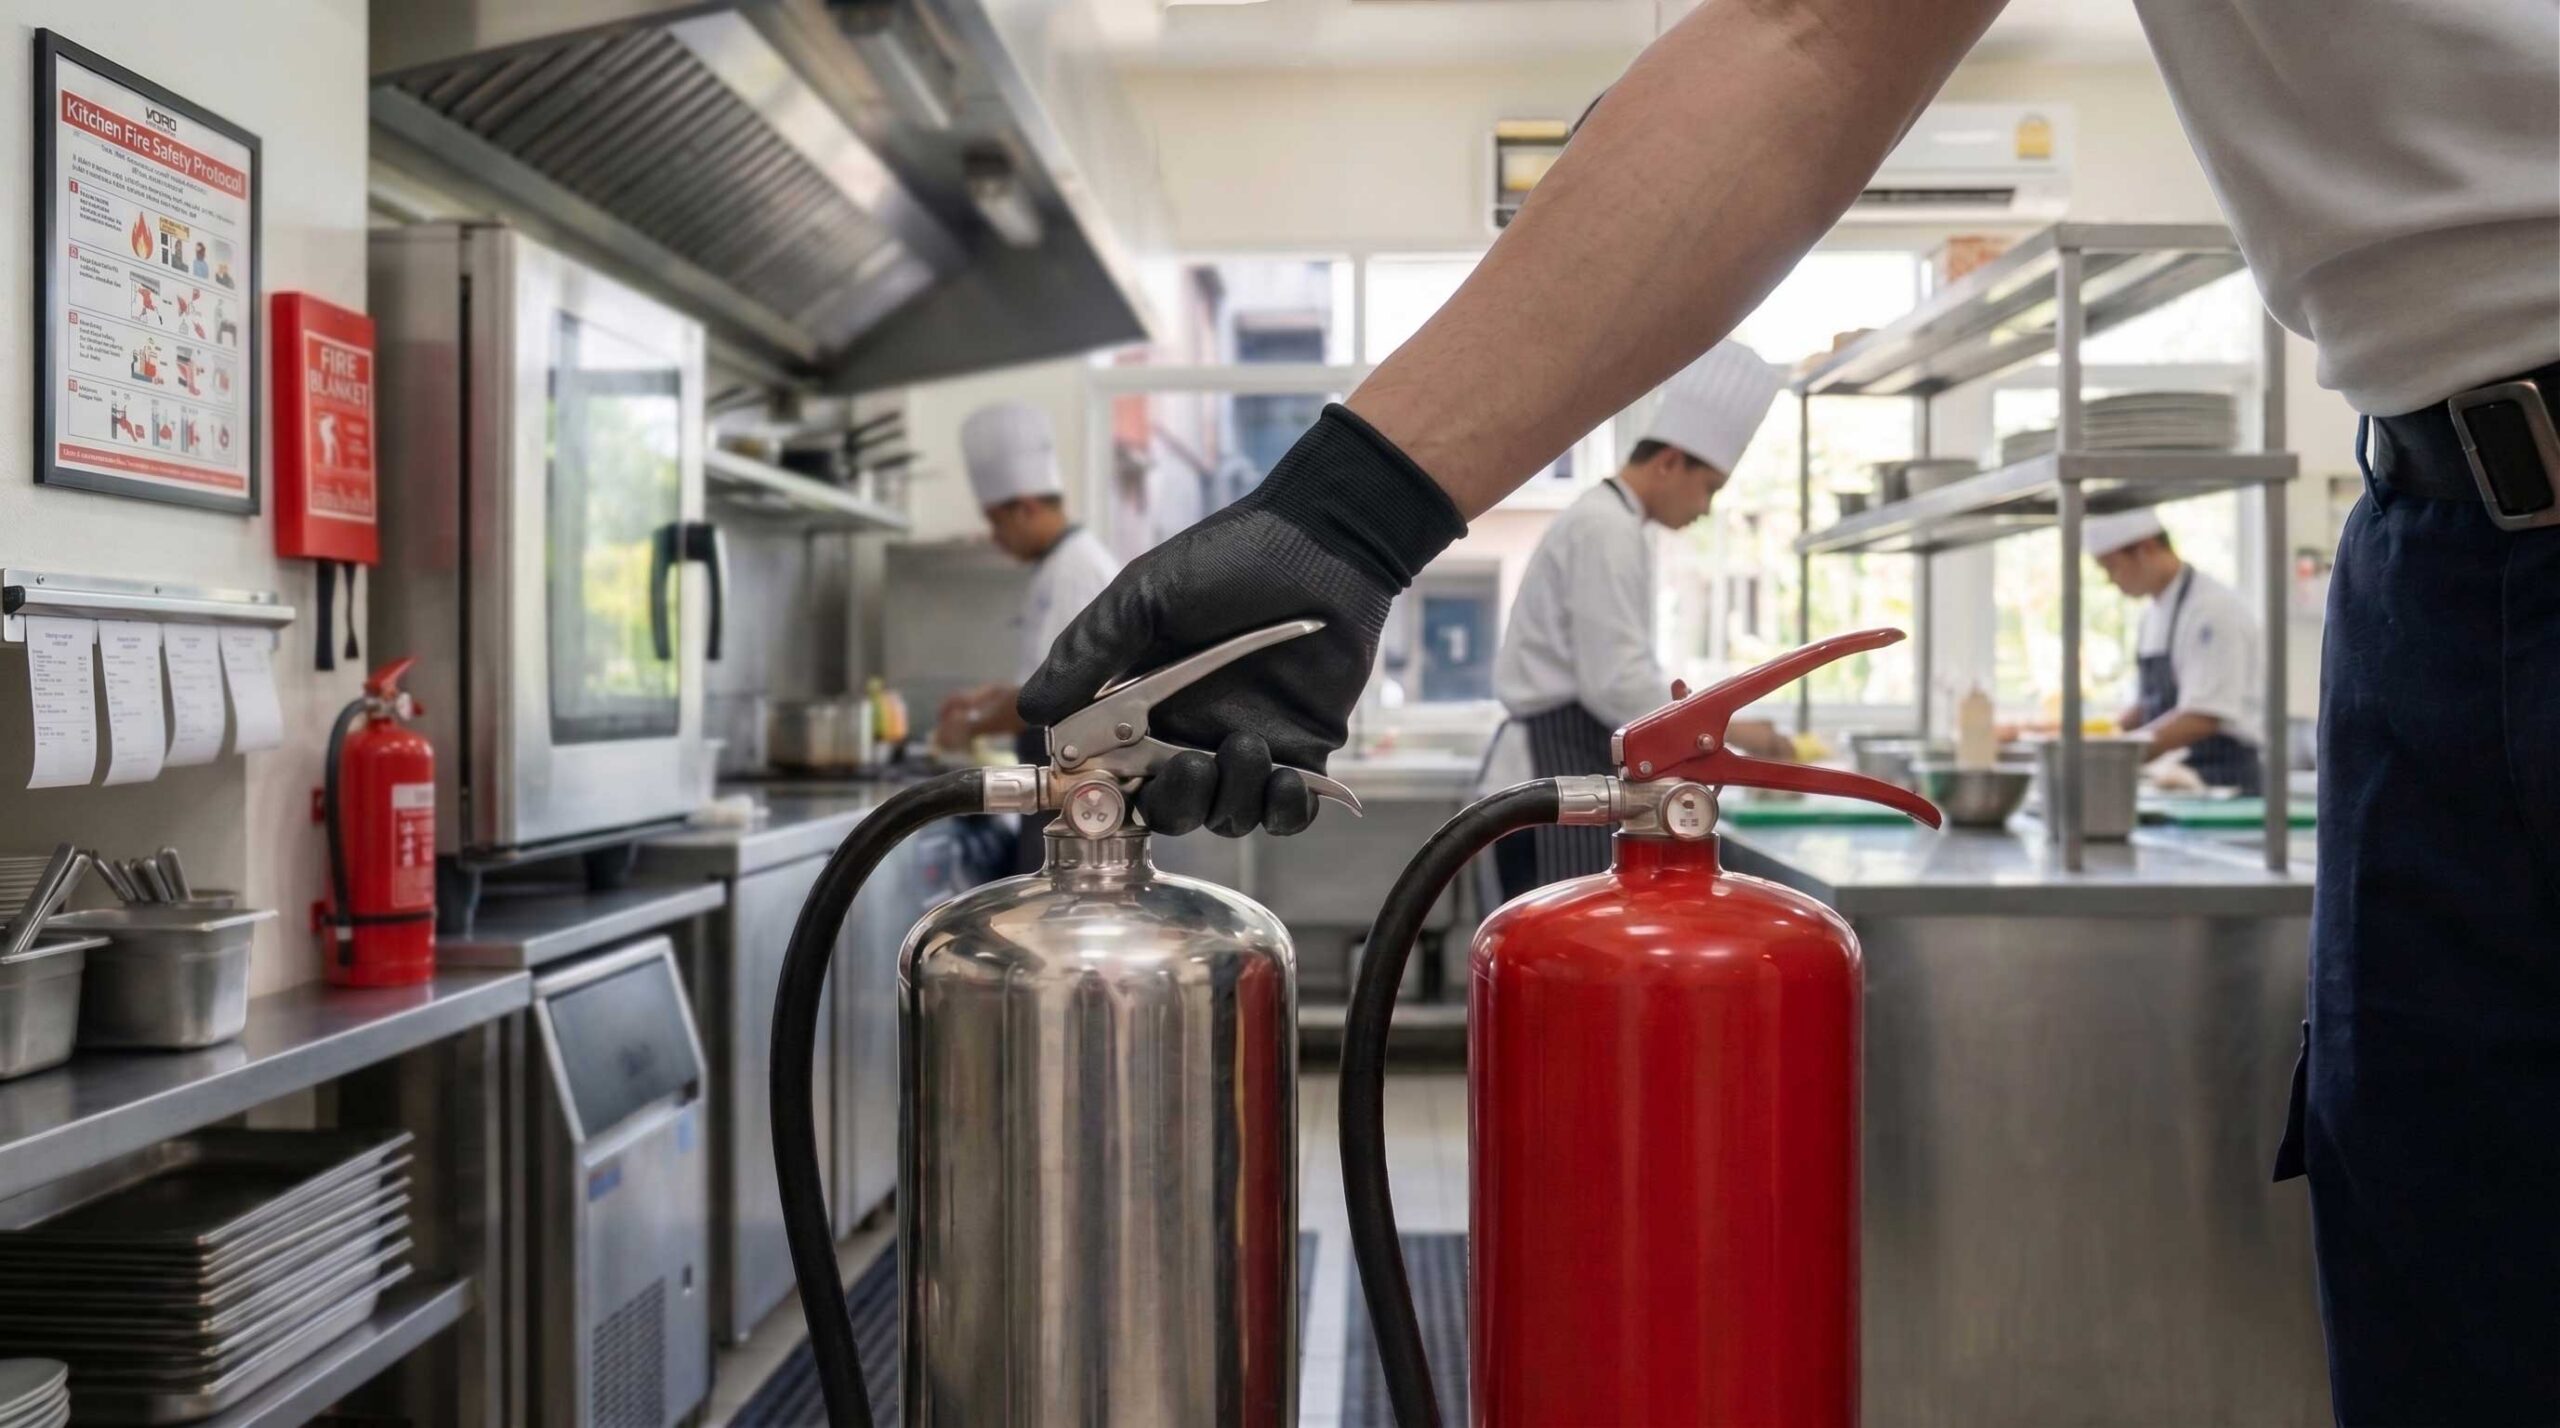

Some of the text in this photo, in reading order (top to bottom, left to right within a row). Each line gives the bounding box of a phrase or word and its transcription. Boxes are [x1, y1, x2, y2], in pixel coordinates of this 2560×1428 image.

[67, 97, 122, 140] Kitchen
[125, 124, 151, 152] Fire
[153, 138, 192, 174] Safety
[145, 106, 177, 132] VORO
[321, 346, 356, 378] FIRE
[309, 370, 367, 406] BLANKET
